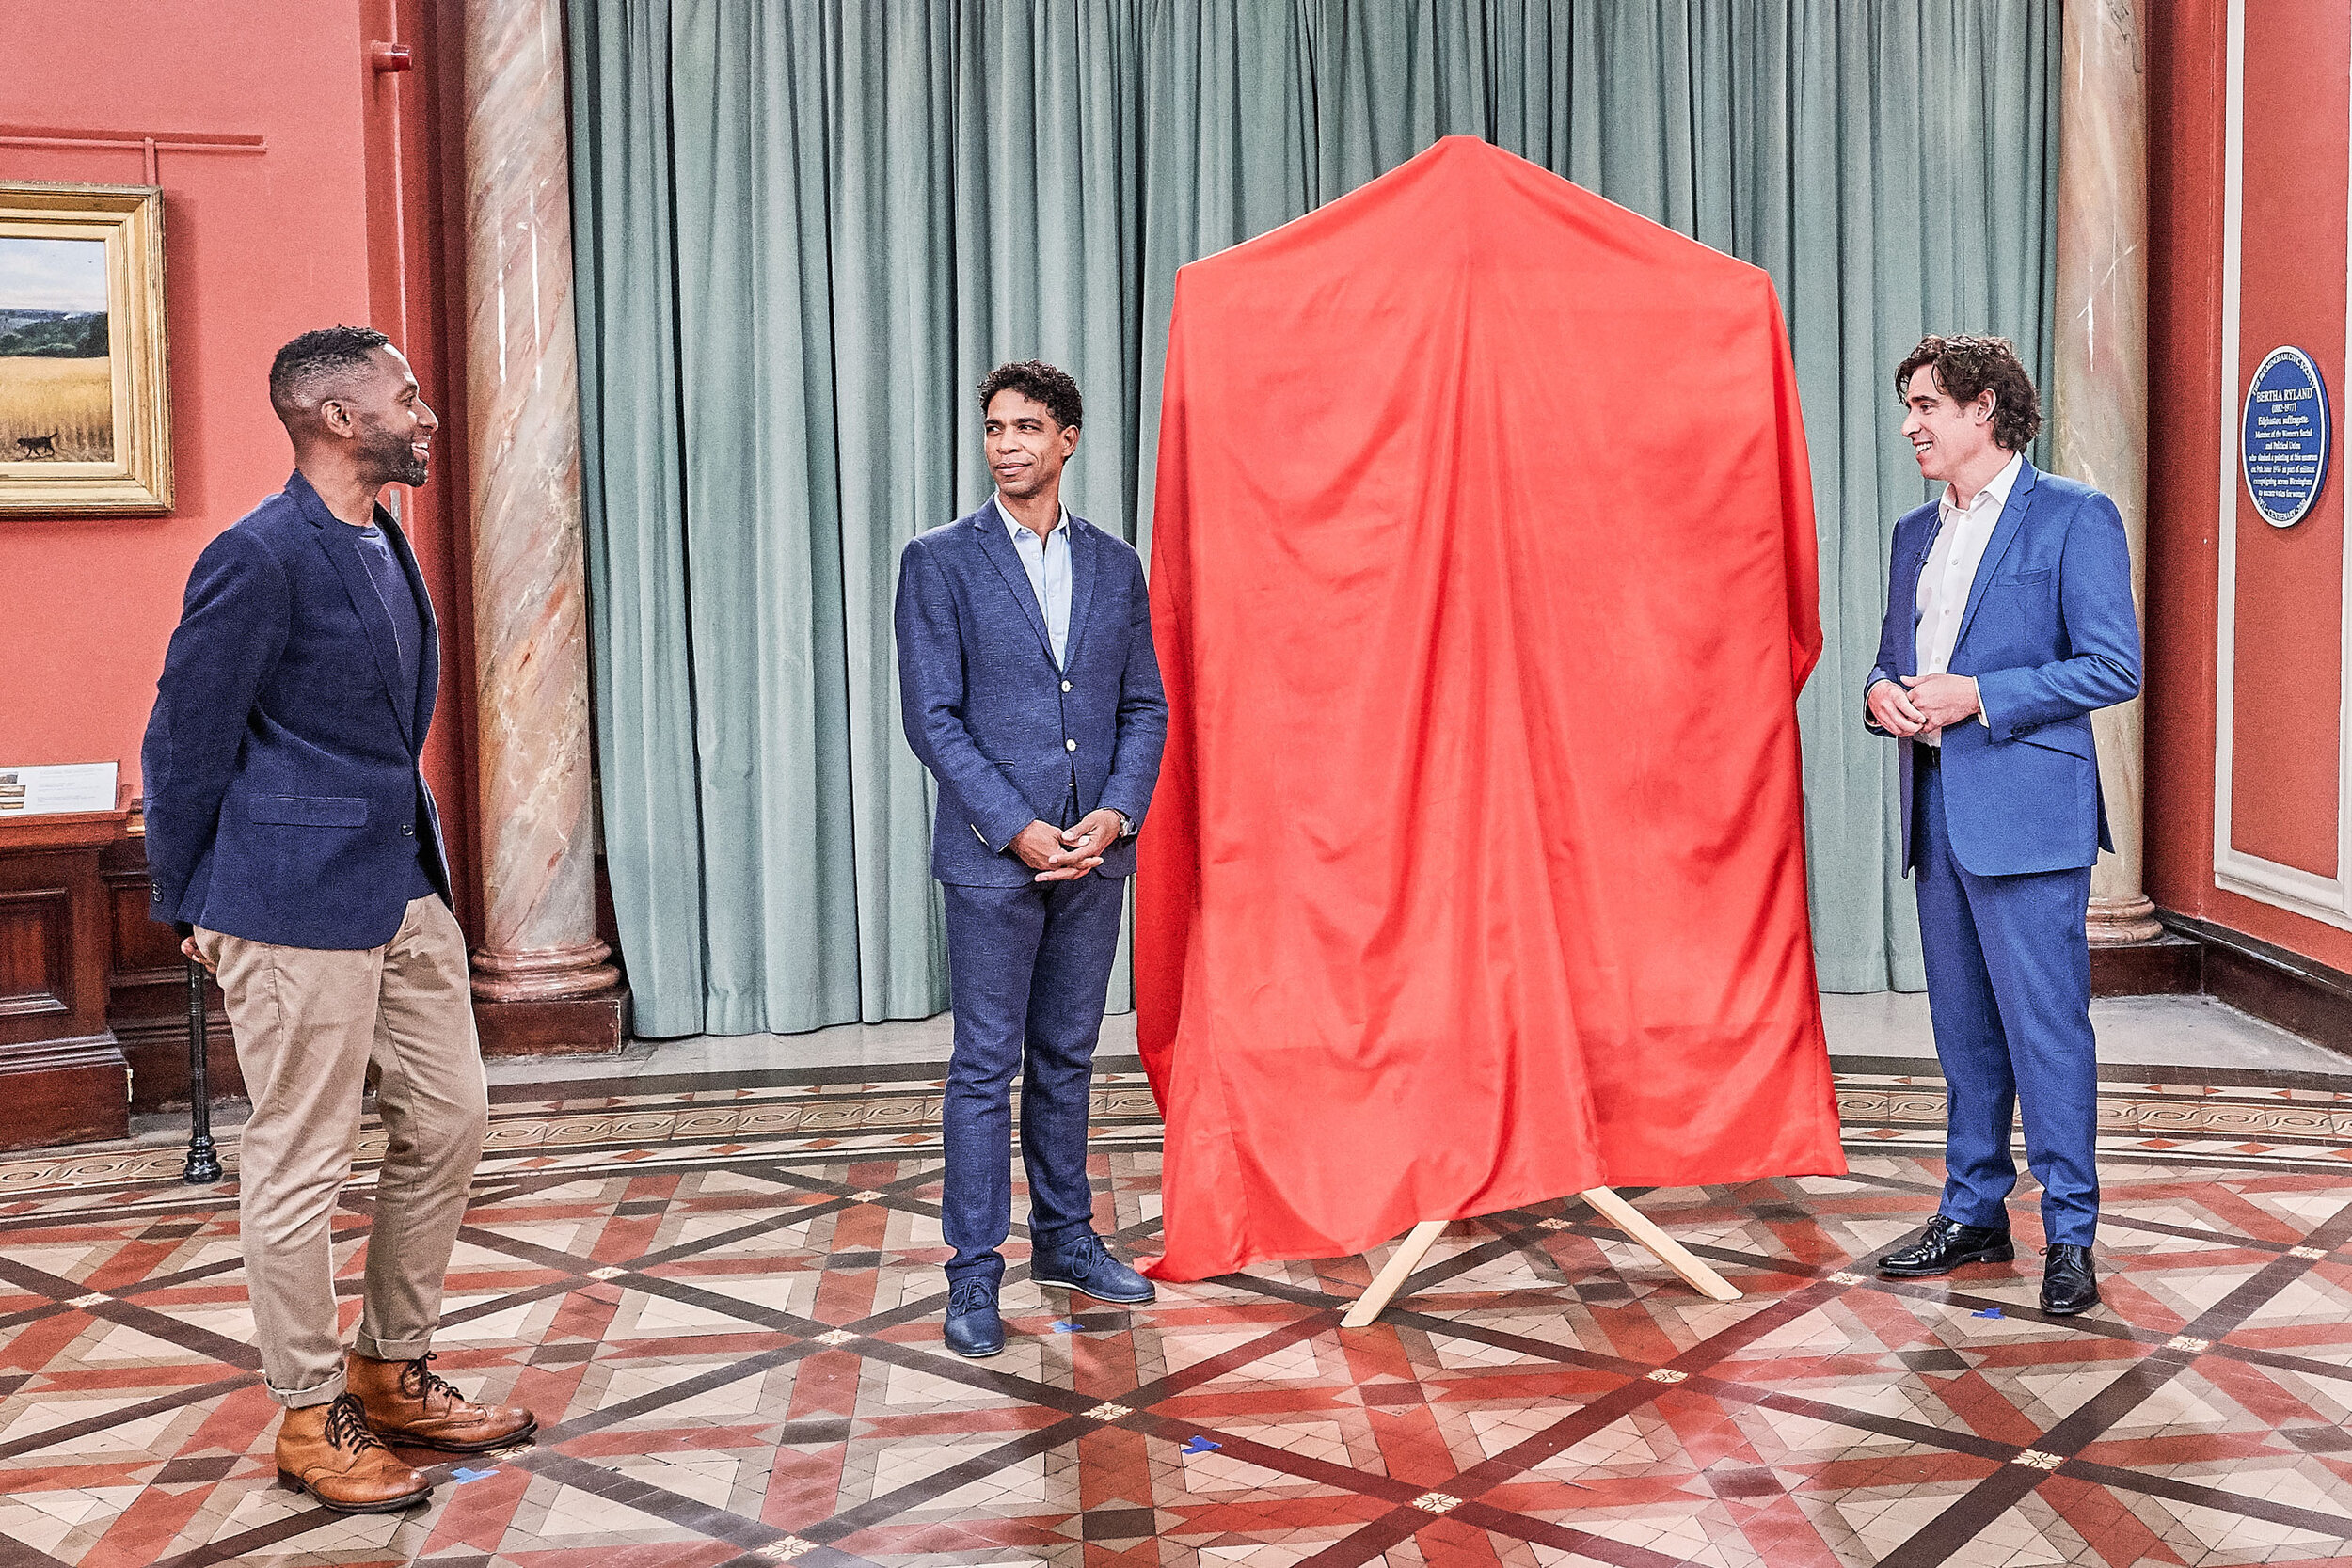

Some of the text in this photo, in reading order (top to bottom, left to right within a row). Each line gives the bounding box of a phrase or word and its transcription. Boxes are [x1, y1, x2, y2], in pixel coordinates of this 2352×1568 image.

[2288, 353, 2301, 366] CIVIC
[2257, 388, 2313, 402] BERTHA RYLAND
[2255, 430, 2270, 439] Member
[2271, 430, 2275, 438] of
[2273, 441, 2288, 449] Political
